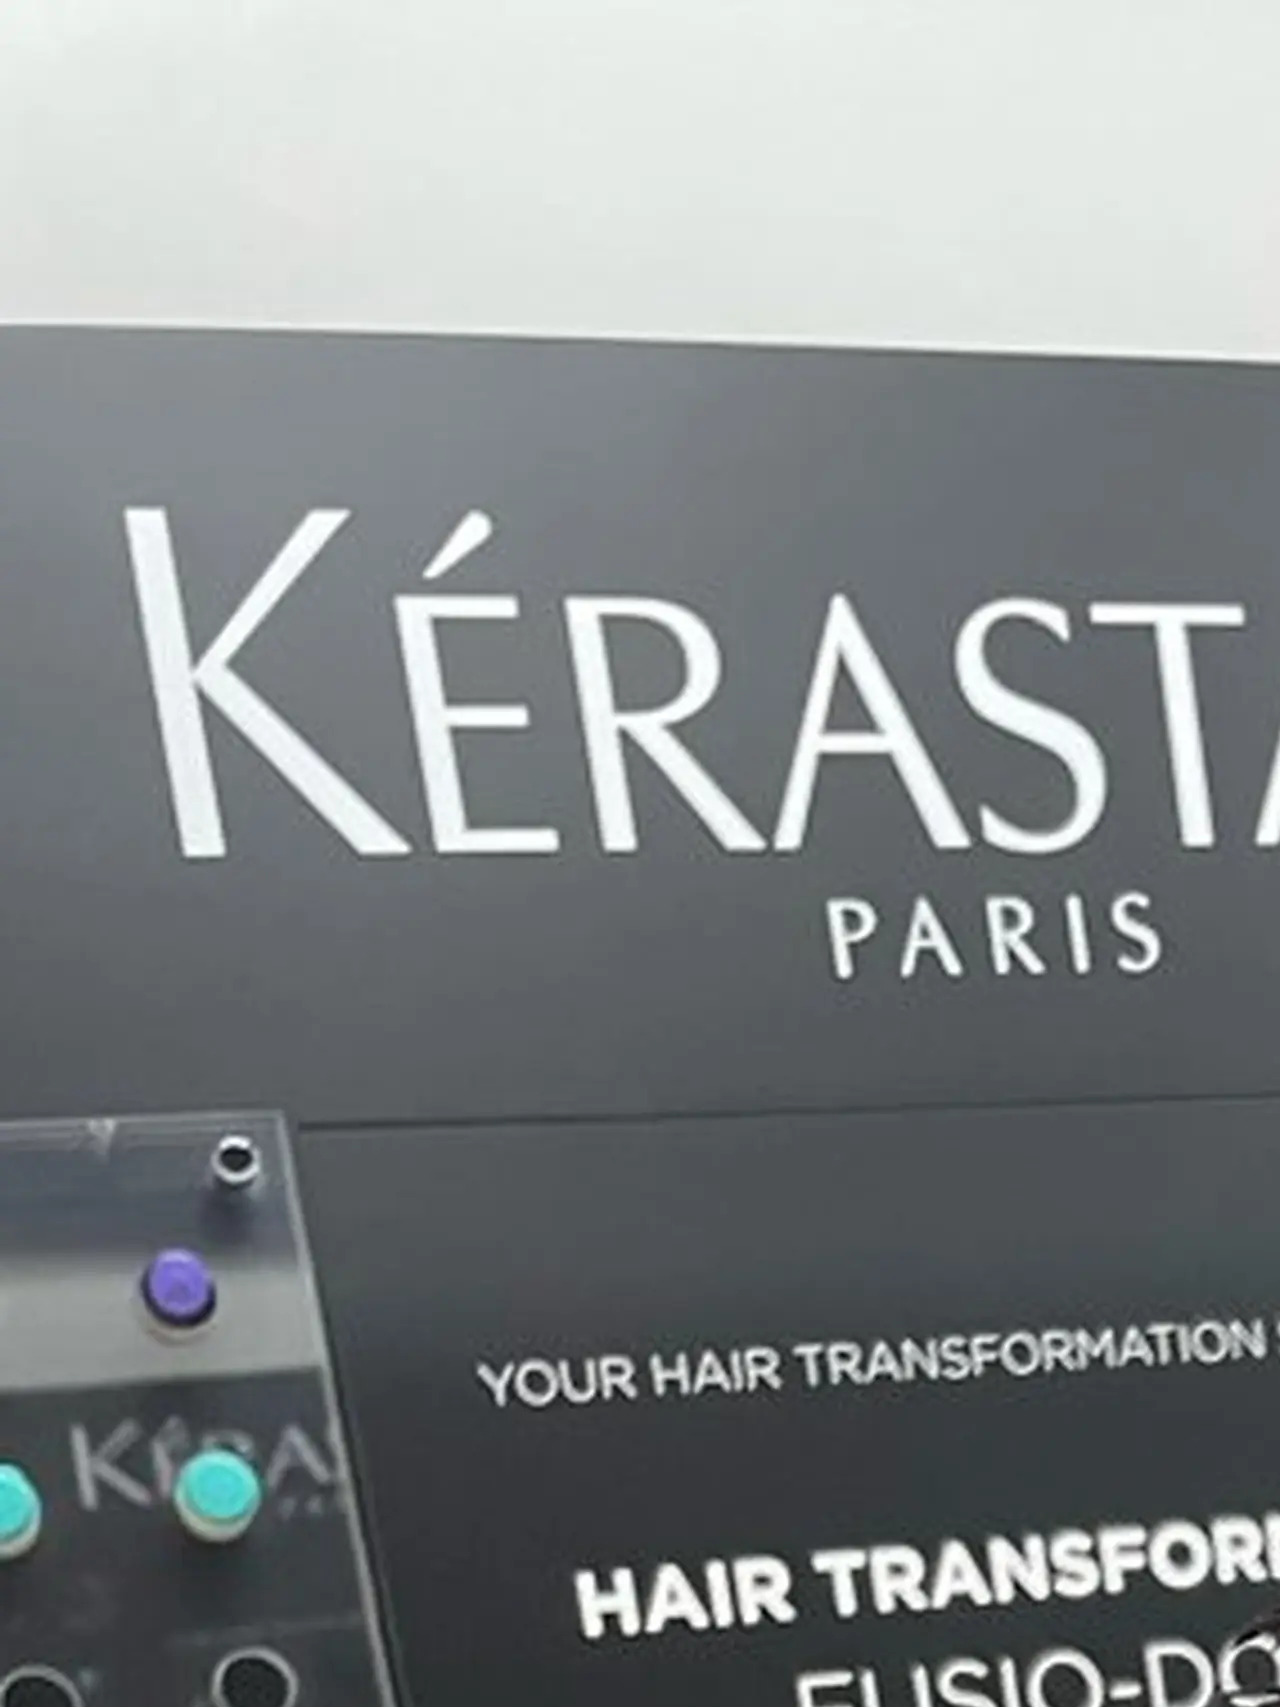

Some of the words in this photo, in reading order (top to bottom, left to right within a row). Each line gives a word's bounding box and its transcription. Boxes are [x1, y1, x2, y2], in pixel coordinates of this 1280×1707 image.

[827, 891, 1161, 979] PARIS
[476, 1355, 638, 1407] YOUR
[649, 1346, 783, 1397] HAIR
[792, 1319, 1267, 1388] TRANSFORMATION
[575, 1556, 797, 1638] HAIR
